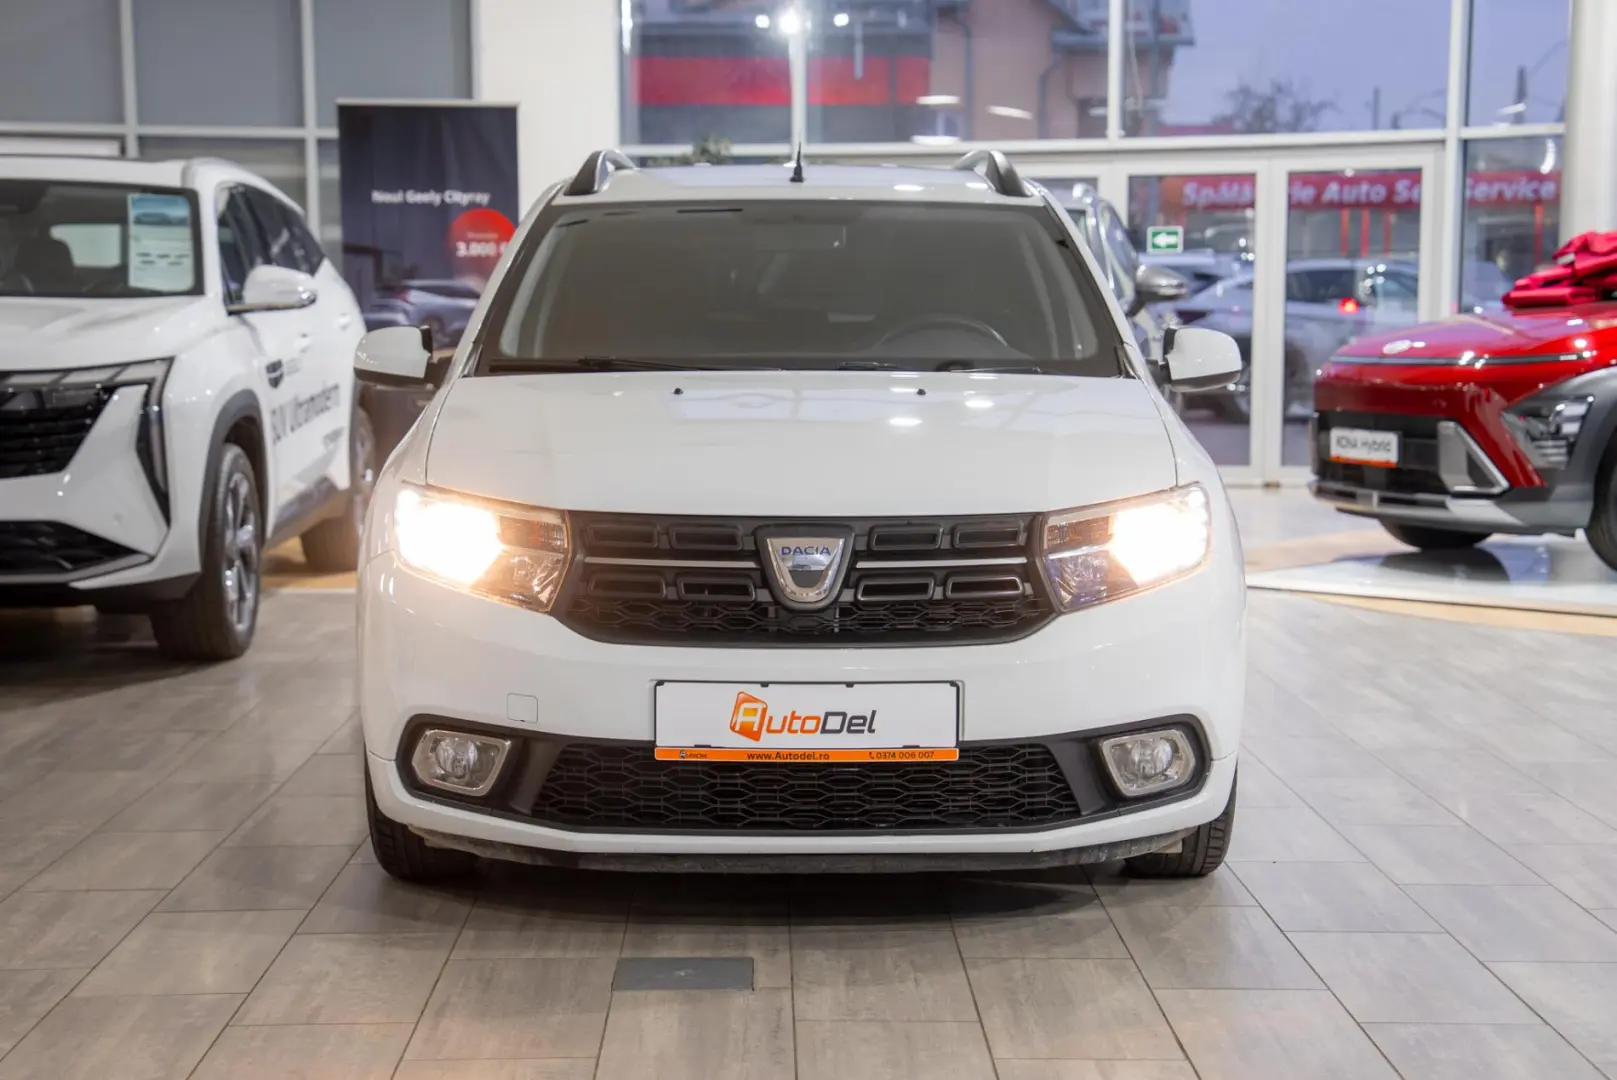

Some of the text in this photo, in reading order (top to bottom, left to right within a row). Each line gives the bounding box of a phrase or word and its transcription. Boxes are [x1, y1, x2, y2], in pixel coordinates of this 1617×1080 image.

[1322, 180, 1387, 204] Auto
[781, 546, 831, 555] DACIA
[731, 697, 877, 736] AutoDel
[747, 751, 830, 760] www.Autodel.ro
[876, 751, 935, 760] 0374 006 007
